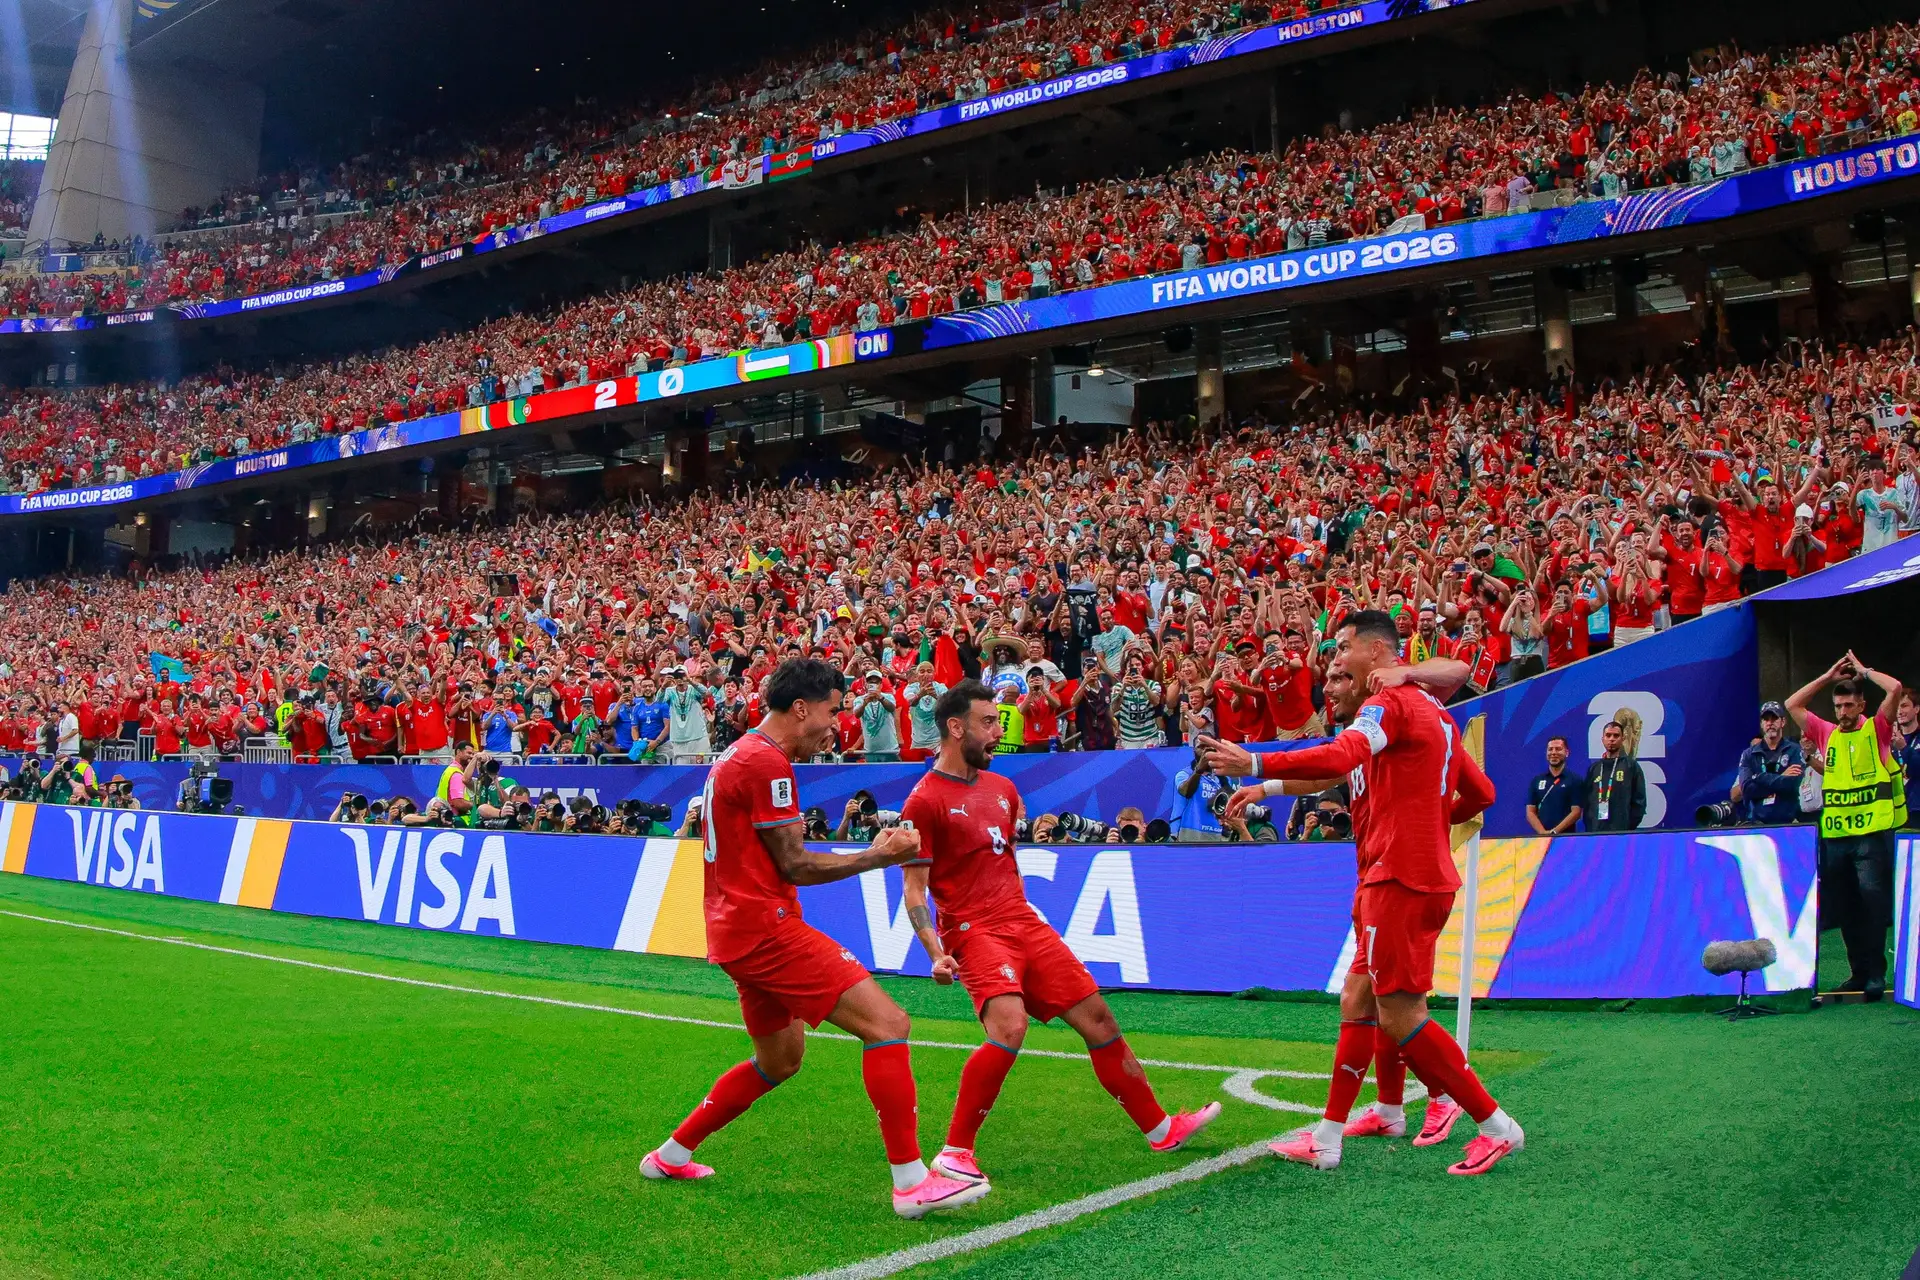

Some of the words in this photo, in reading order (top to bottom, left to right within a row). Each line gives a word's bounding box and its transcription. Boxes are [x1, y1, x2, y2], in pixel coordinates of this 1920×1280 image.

[1278, 9, 1363, 41] HOUSTON
[960, 101, 989, 119] FIFA
[991, 88, 1042, 111] WORLD
[1044, 79, 1073, 97] CUP
[1075, 66, 1127, 90] 2026
[421, 247, 463, 269] HOUSTON
[1152, 276, 1205, 303] FIFA
[1207, 259, 1300, 293] WORLD
[1303, 250, 1356, 278] CUP
[1360, 233, 1457, 269] 2026
[241, 297, 261, 310] FIFA
[261, 291, 294, 306] WORLD
[294, 287, 312, 300] CUP
[312, 281, 345, 296] 2026
[106, 311, 154, 325] HOUSTON
[856, 333, 888, 356] ON
[594, 380, 617, 411] 2
[1877, 406, 1893, 419] TE
[235, 452, 288, 475] HOUSTON
[20, 497, 42, 510] FIFA
[43, 491, 79, 507] WORLD
[79, 488, 101, 504] CUP
[101, 485, 133, 501] 2026
[1825, 787, 1877, 805] ECURITY
[1825, 812, 1873, 831] 06187
[65, 808, 164, 892] VISA
[987, 825, 1005, 855] 8
[340, 827, 516, 936] VISA
